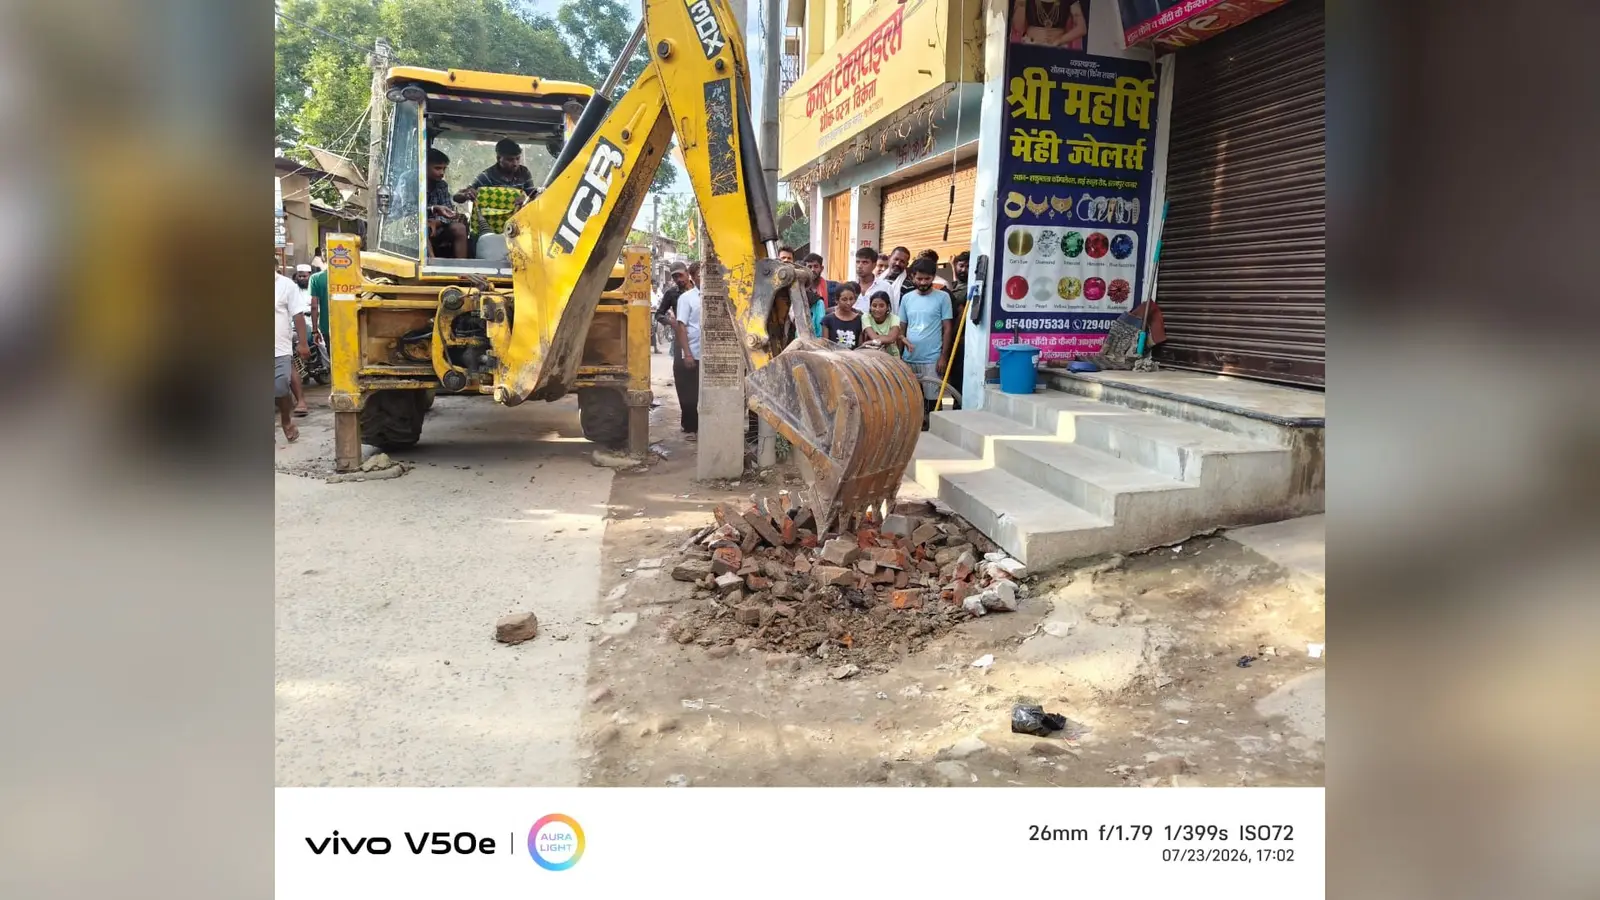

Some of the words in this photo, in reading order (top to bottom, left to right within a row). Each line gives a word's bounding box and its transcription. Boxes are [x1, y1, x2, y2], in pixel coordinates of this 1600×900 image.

[805, 69, 833, 119] कमल
[1006, 66, 1056, 120] श्री
[1061, 76, 1155, 129] महर्षि
[1009, 128, 1062, 164] मेंही
[1066, 133, 1147, 170] ज्वेलर्स
[558, 143, 623, 249] JCB
[330, 284, 357, 293] STOP
[1005, 318, 1070, 330] 8540975334
